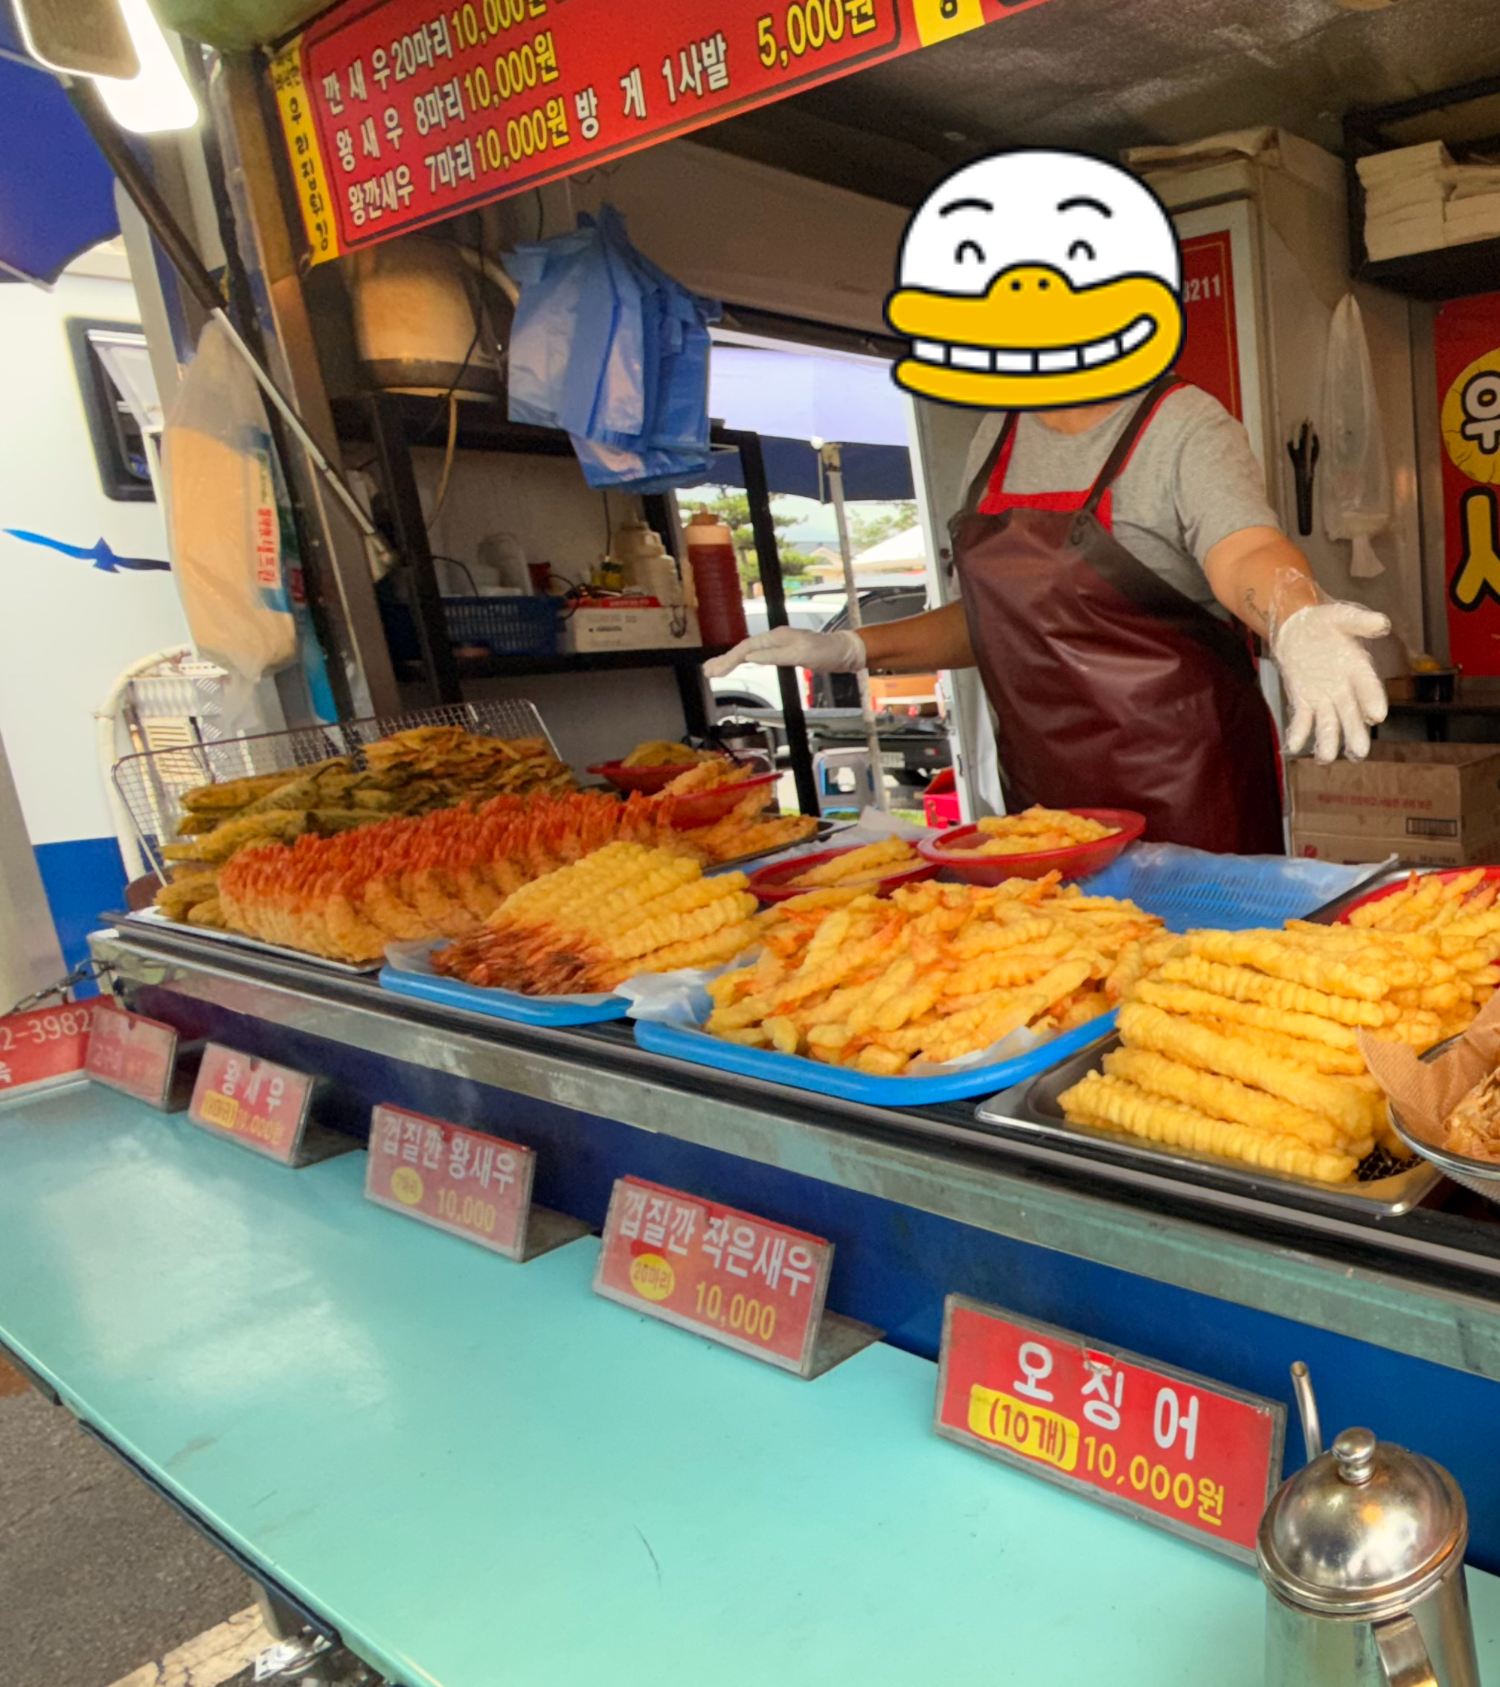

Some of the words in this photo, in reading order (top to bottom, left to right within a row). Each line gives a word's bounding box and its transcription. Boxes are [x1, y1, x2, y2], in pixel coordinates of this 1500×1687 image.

[413, 77, 466, 137] 8마리
[464, 31, 559, 111] 10,000원
[757, 0, 876, 67] 5,000원
[348, 165, 414, 226] 왕깐새우
[425, 138, 476, 192] 7마리
[476, 97, 570, 172] 10,000원
[661, 32, 730, 103] 1사발
[696, 1281, 776, 1341] 10,000
[989, 1398, 1067, 1462] (10개)
[1084, 1436, 1224, 1526] 10,000원
